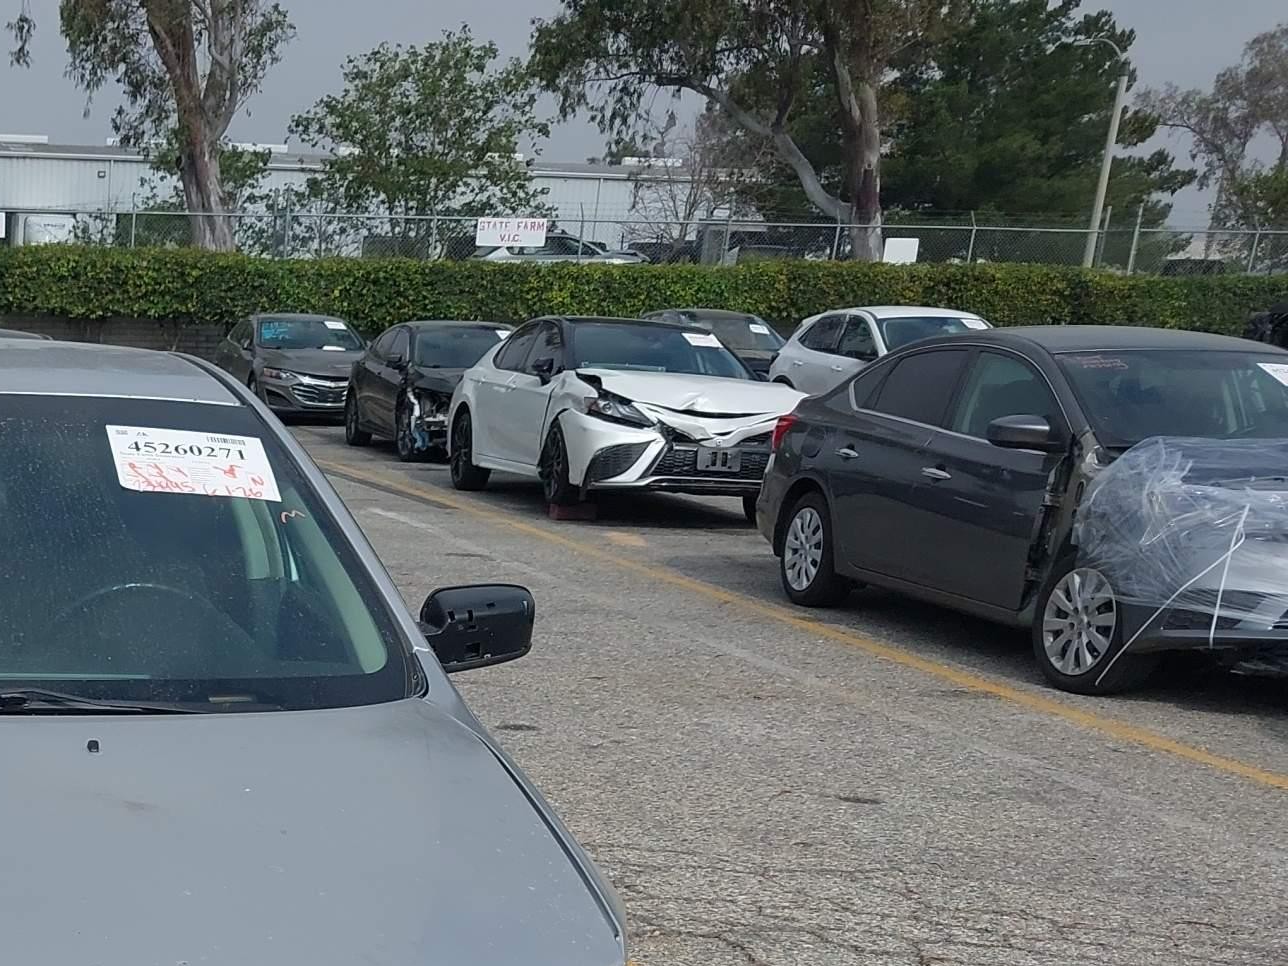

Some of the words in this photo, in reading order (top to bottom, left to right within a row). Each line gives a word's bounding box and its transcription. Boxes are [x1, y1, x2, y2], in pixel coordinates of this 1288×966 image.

[479, 221, 511, 231] STATE
[517, 221, 545, 232] FARM
[127, 440, 248, 461] 45260271
